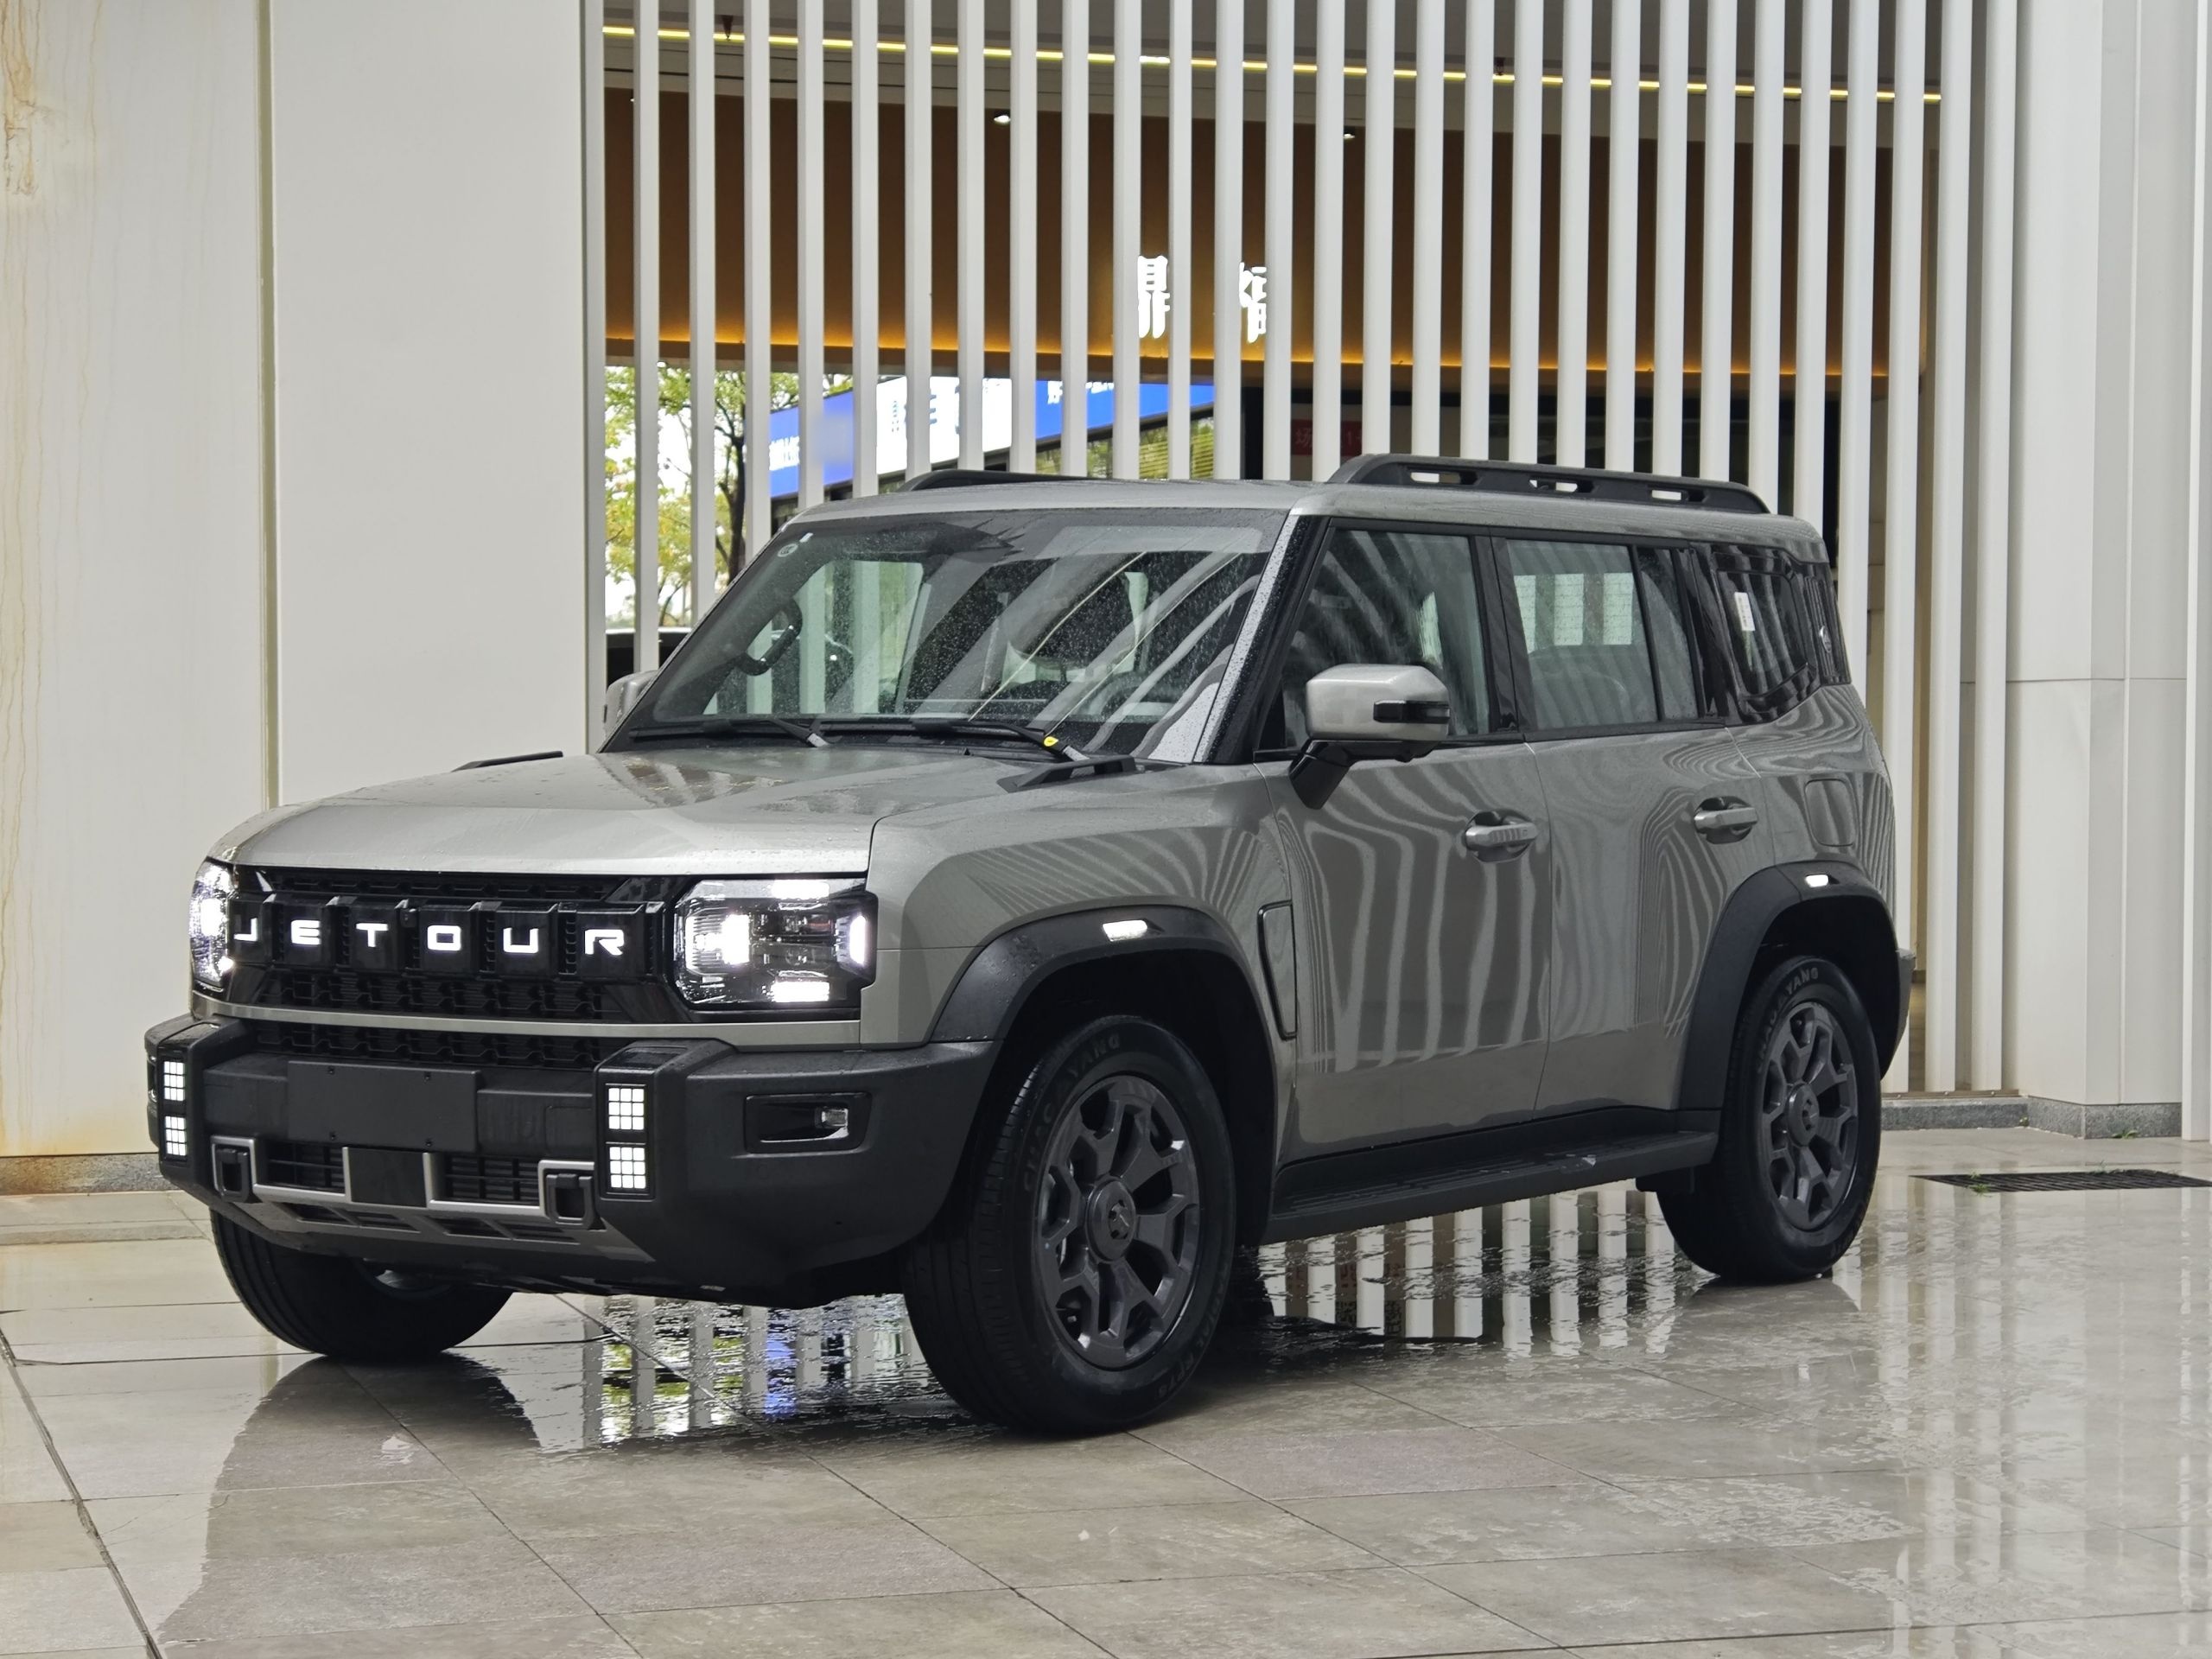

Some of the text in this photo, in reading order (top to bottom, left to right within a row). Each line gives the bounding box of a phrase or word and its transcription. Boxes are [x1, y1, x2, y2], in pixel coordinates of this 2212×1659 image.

[233, 918, 625, 956] JETOUR
[1785, 967, 1818, 995] YANG
[1067, 1033, 1120, 1077] YANG
